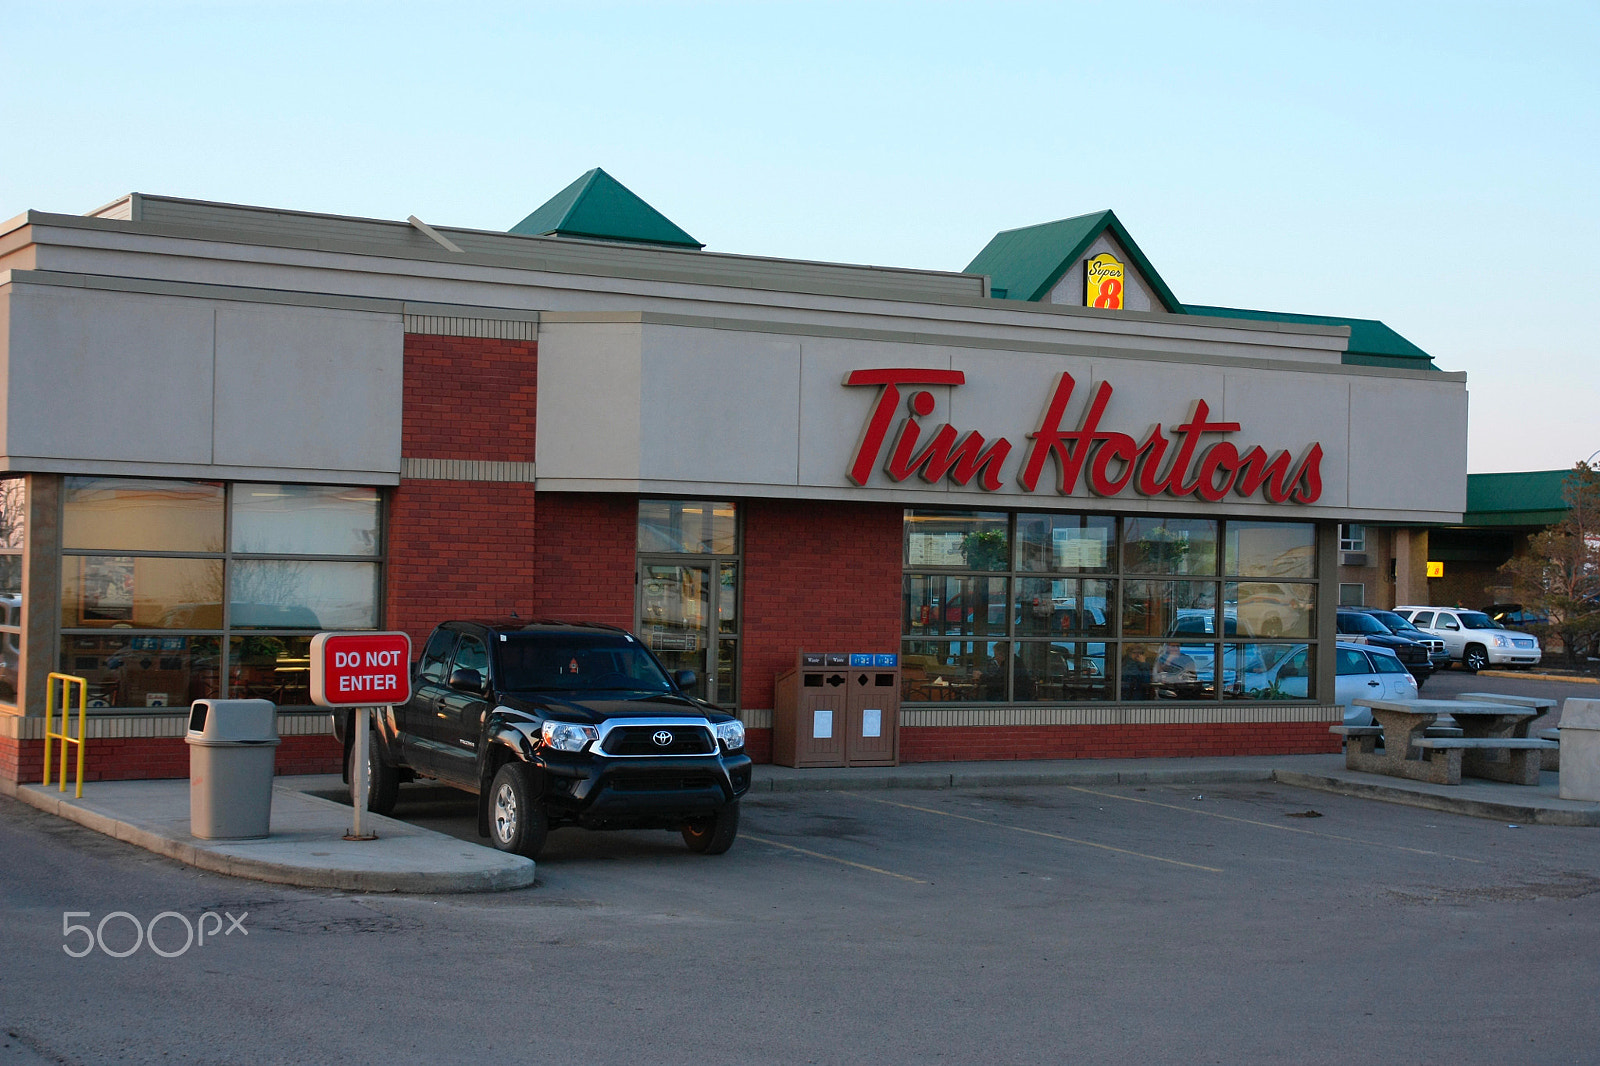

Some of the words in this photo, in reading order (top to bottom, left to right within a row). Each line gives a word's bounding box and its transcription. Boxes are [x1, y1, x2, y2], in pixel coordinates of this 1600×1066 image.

[1089, 261, 1121, 283] Super
[1094, 279, 1121, 309] 8
[841, 368, 1012, 491] Tim
[1017, 371, 1324, 504] Hortons
[335, 652, 361, 668] DO
[366, 650, 401, 667] NOT
[339, 674, 397, 691] ENTER
